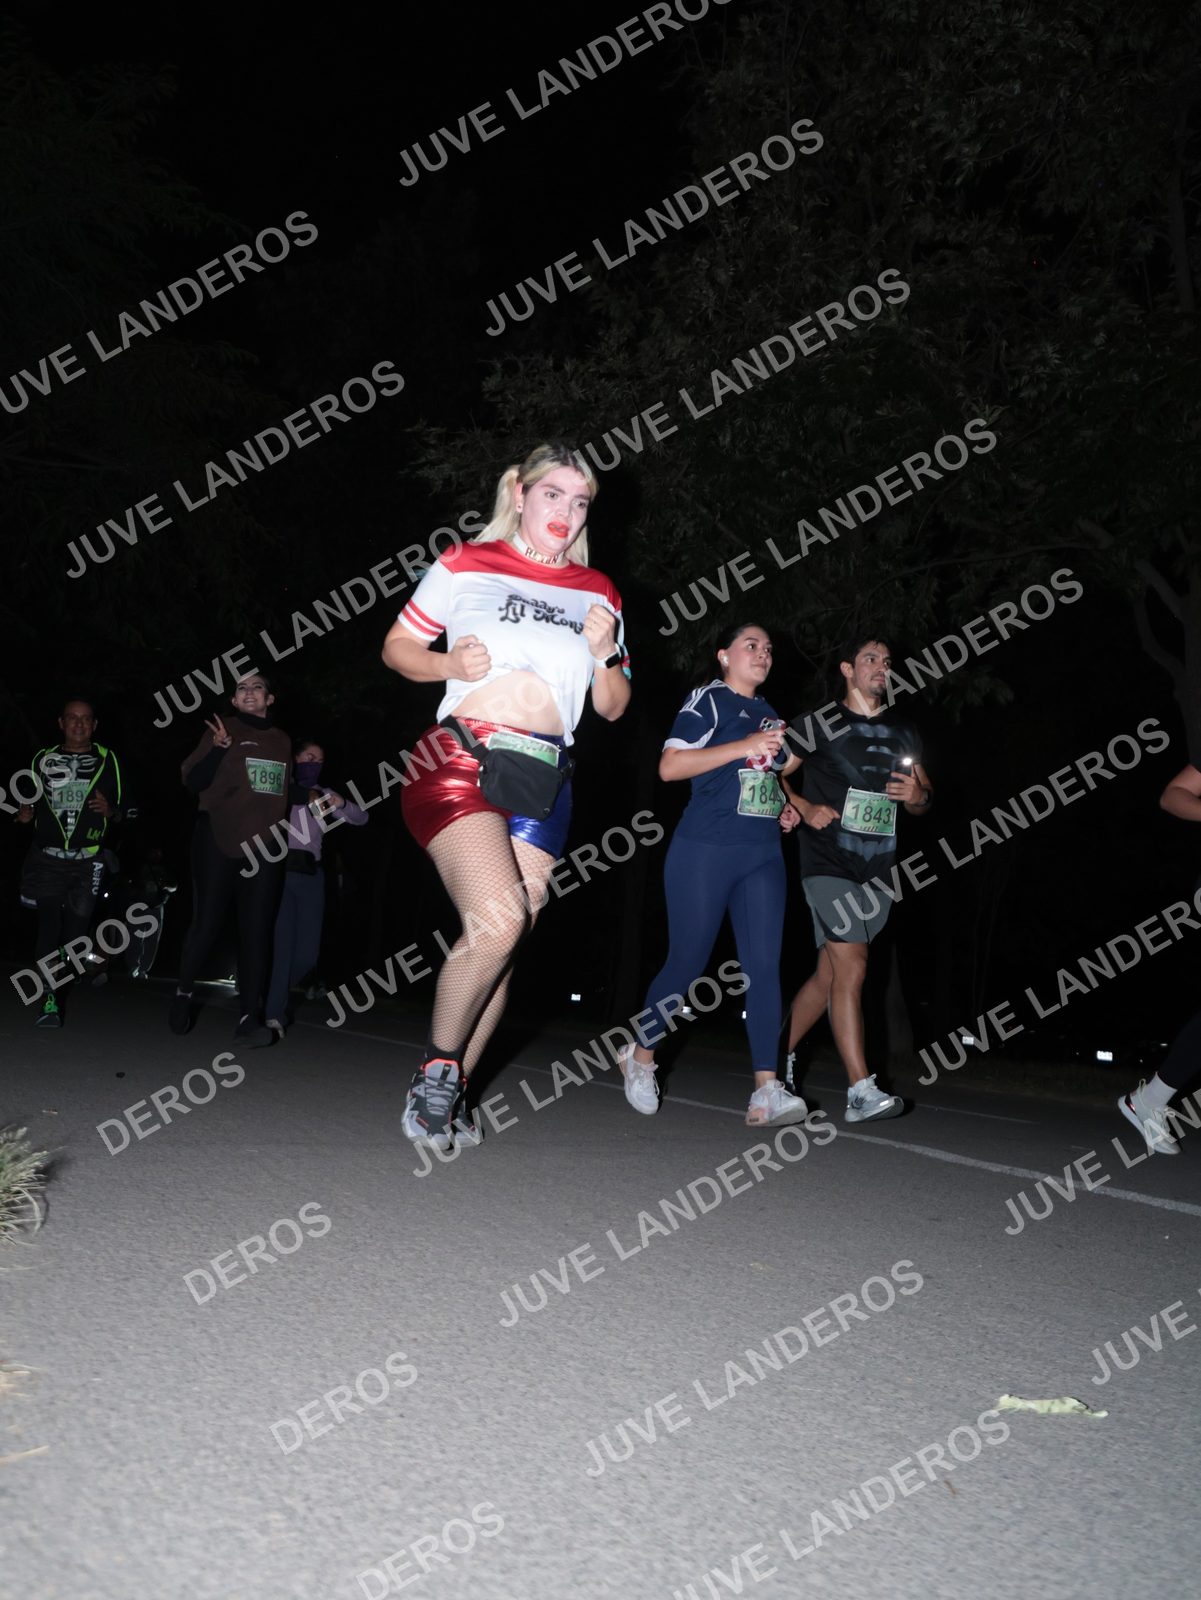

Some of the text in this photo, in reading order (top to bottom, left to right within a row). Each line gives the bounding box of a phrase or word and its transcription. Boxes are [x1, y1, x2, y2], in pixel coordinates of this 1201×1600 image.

[251, 770, 282, 786] 1896
[57, 790, 84, 803] 189
[852, 804, 892, 825] 1843
